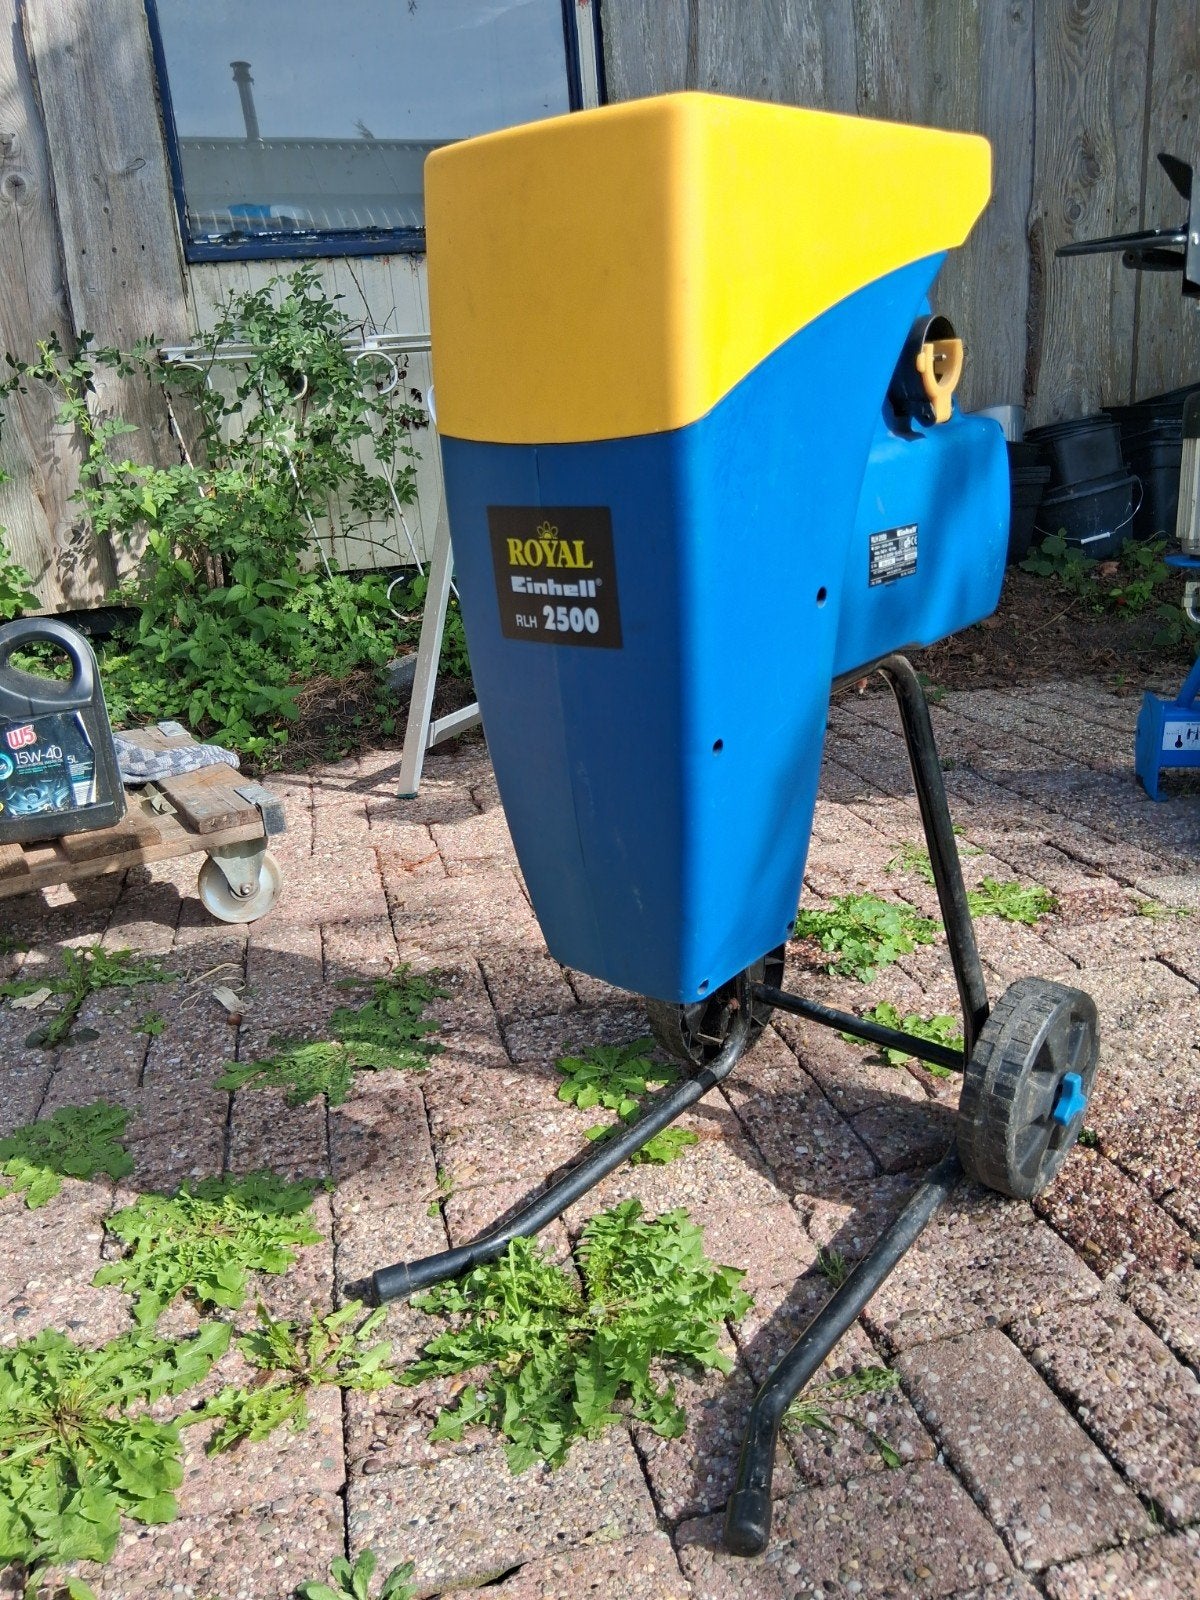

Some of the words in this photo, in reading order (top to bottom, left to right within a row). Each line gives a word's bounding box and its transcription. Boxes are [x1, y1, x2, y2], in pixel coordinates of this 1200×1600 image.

[507, 538, 594, 569] ROYAL
[510, 575, 597, 598] Einhell
[515, 614, 538, 629] RLH
[542, 605, 600, 634] 2500
[6, 725, 37, 750] W5
[14, 746, 63, 765] 15W-40
